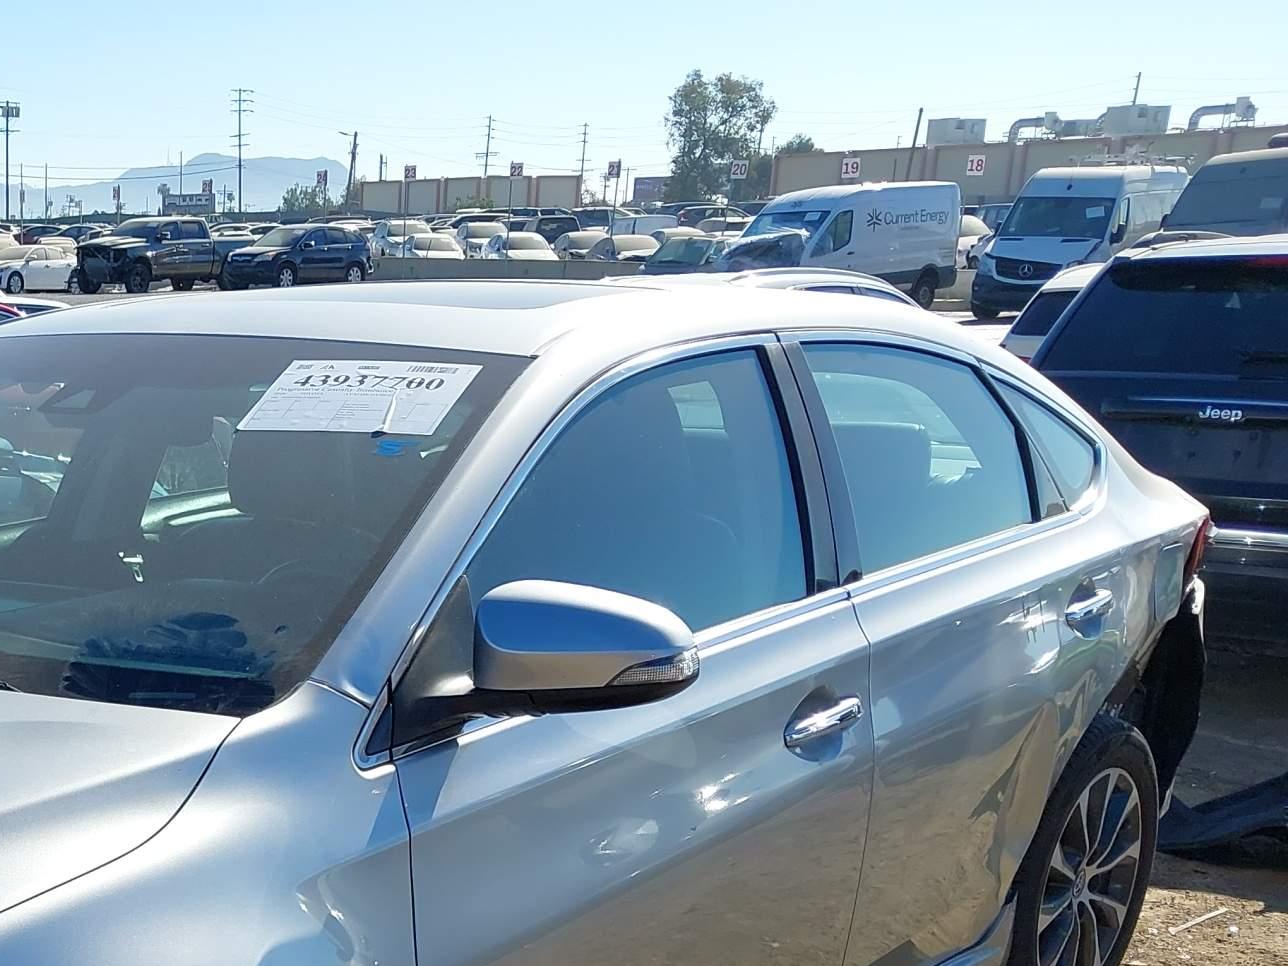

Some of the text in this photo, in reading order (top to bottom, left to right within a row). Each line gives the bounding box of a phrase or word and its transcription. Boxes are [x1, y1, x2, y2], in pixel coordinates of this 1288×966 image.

[512, 165, 523, 176] 22
[608, 165, 618, 176] 21
[732, 163, 746, 175] 20
[842, 162, 859, 174] 19
[968, 159, 984, 172] 18
[405, 168, 416, 178] 23
[884, 208, 950, 225] Current Energy
[293, 373, 446, 391] 43937700
[1198, 405, 1243, 422] Jeep
